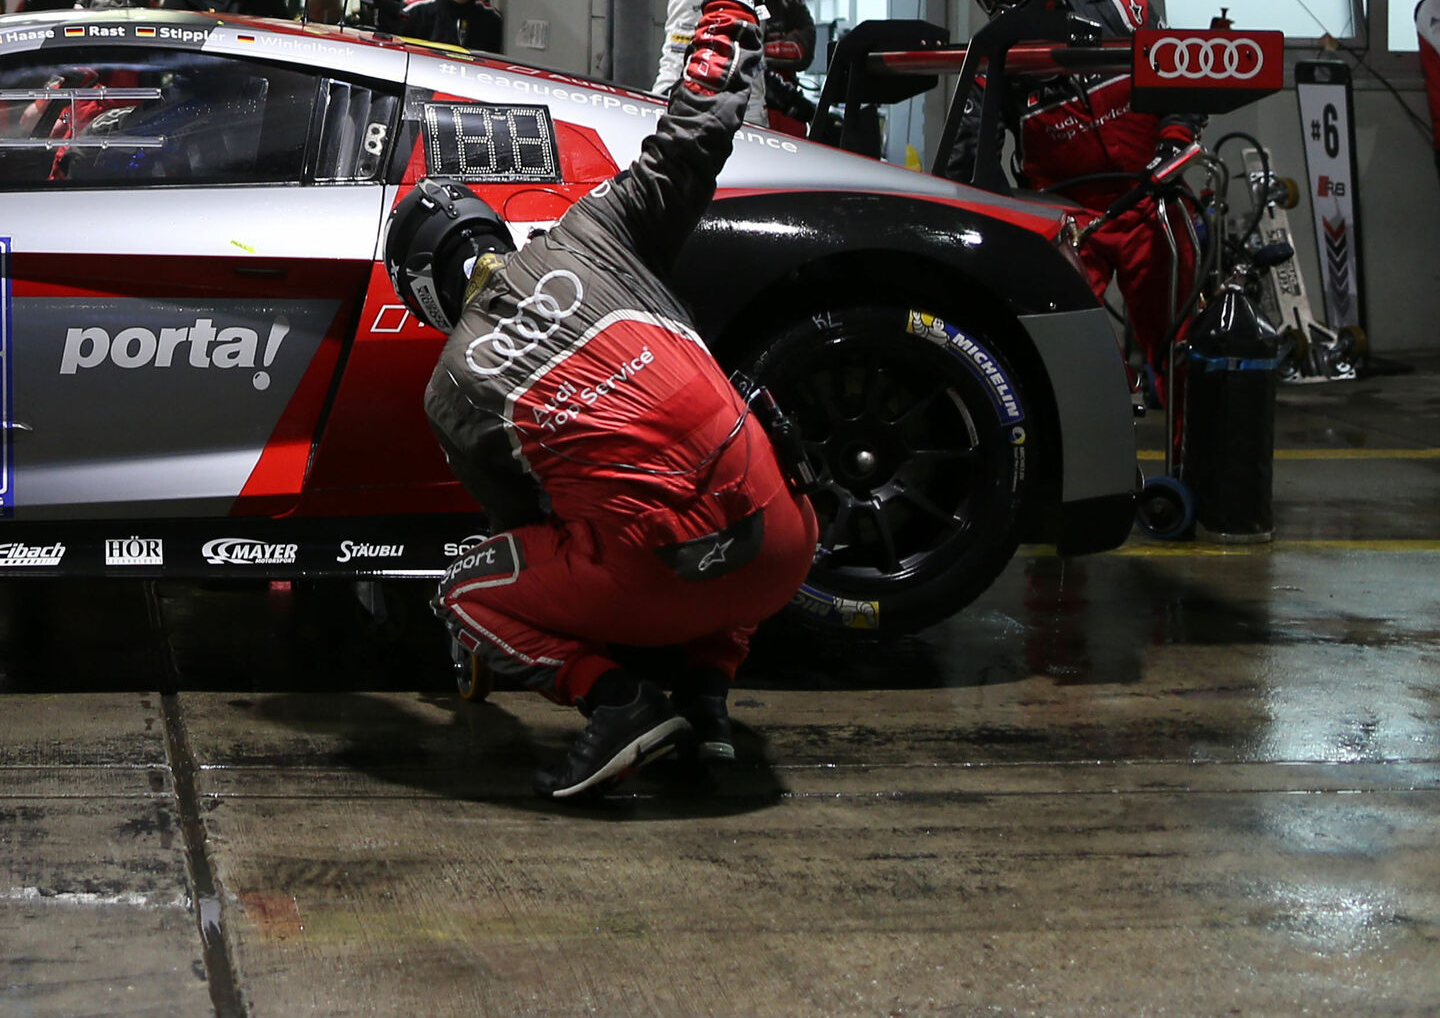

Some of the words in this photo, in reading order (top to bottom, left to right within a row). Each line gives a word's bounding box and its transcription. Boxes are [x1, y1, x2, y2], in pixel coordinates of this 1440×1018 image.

[6, 28, 55, 42] Haase
[89, 26, 125, 37] Rast
[160, 27, 225, 42] Stippler
[259, 35, 355, 57] Winkelhock
[60, 314, 291, 391] porta!
[951, 332, 1021, 418] MICHELIN
[540, 401, 581, 433] Top
[579, 345, 656, 406] Service
[532, 380, 578, 424] Audi
[107, 535, 161, 559] HÖR
[231, 544, 299, 560] MAYER
[337, 539, 405, 563] STÄUBLI
